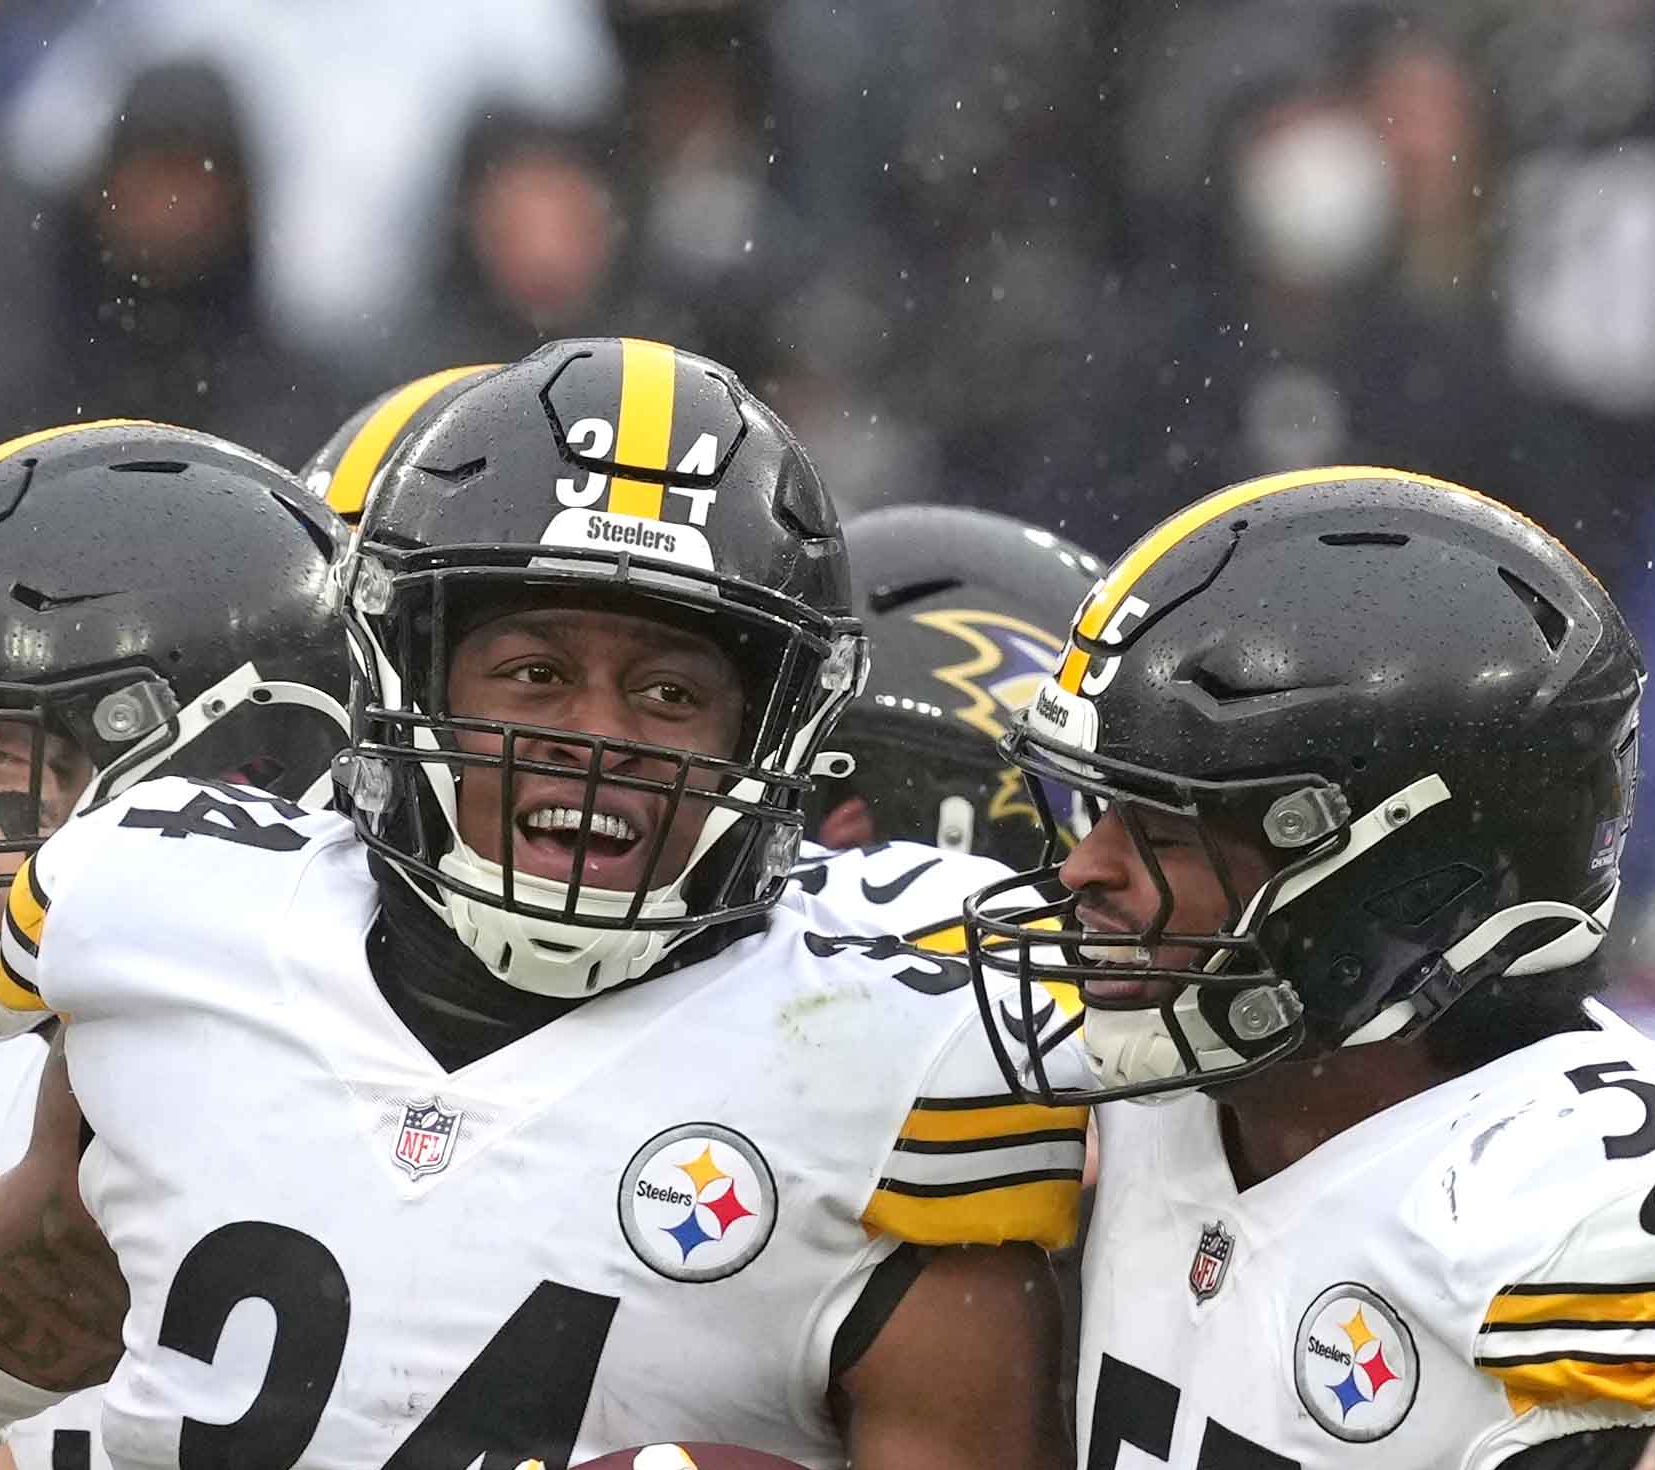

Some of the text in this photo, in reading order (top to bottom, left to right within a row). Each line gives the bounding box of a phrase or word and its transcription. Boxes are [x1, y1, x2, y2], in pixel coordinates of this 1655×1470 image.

[586, 515, 677, 554] Steelers
[400, 1130, 440, 1164] NFL
[636, 1180, 693, 1207] Steelers
[1192, 1252, 1218, 1290] NFL
[1308, 1335, 1352, 1367] Steelers
